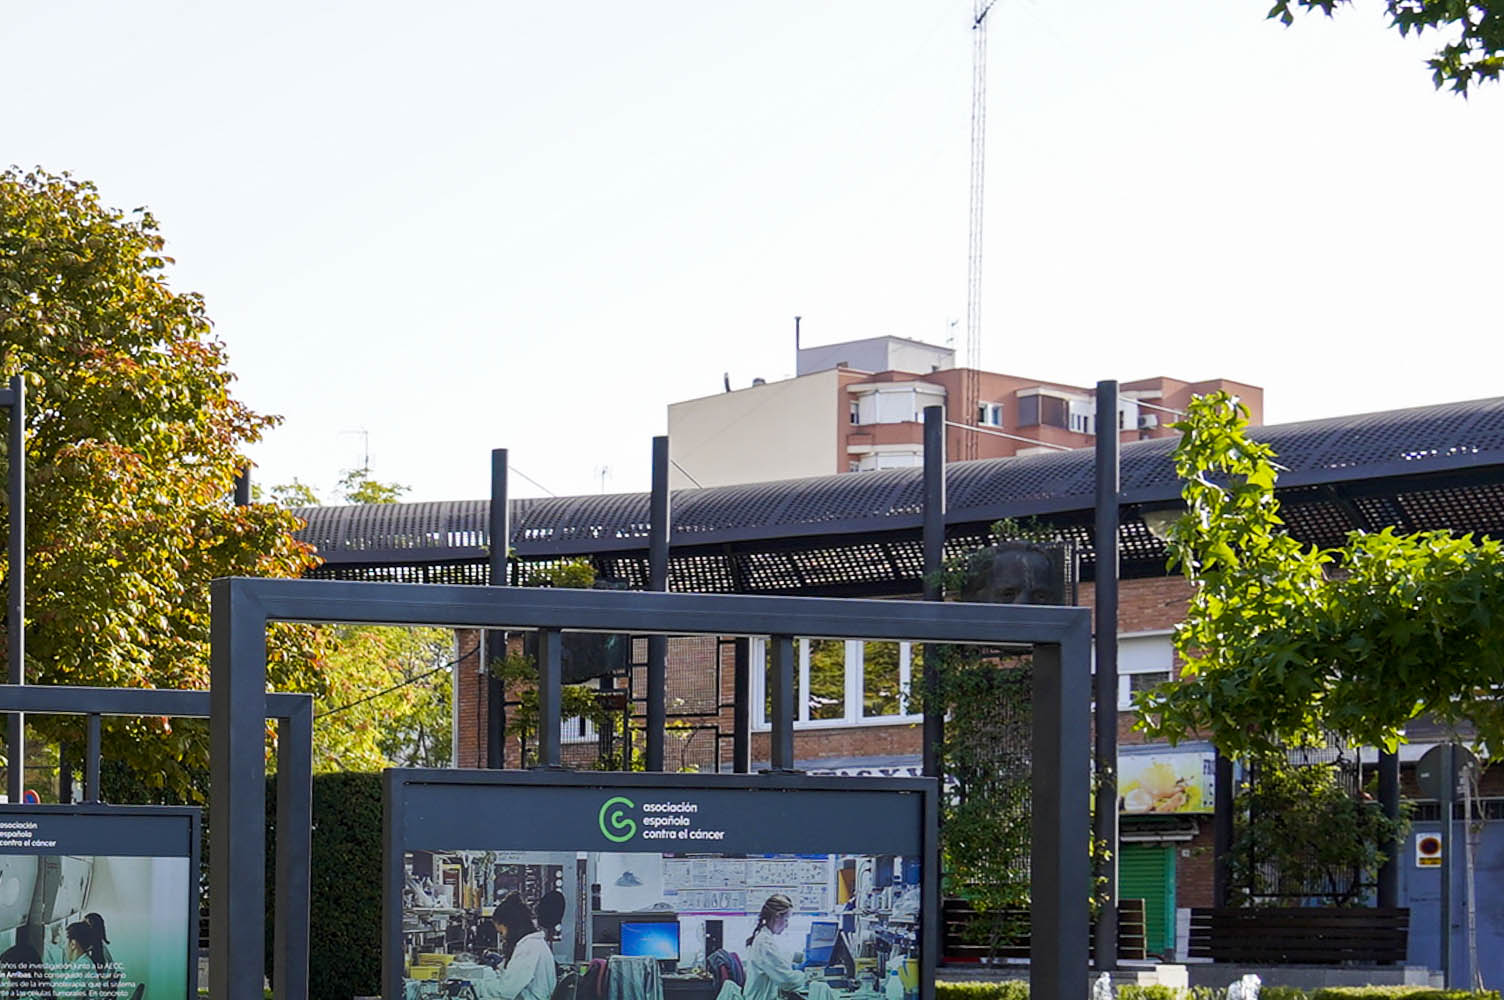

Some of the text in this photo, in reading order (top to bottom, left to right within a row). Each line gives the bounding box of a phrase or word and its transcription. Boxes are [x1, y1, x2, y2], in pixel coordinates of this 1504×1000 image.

[643, 801, 698, 812] asociación
[643, 815, 690, 827] española
[643, 829, 725, 840] contra el cáncer
